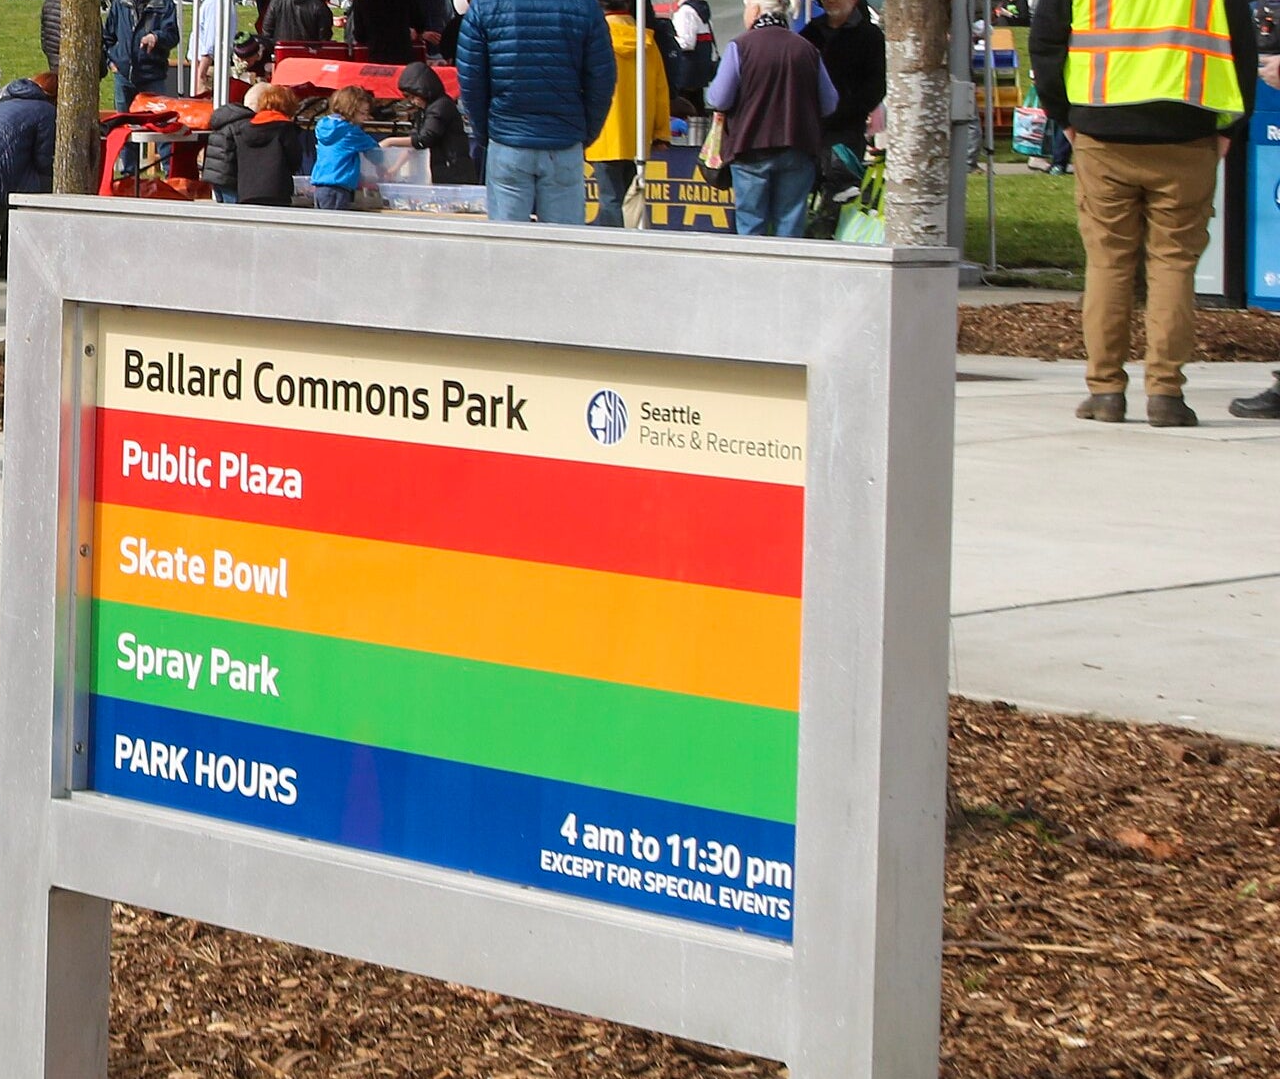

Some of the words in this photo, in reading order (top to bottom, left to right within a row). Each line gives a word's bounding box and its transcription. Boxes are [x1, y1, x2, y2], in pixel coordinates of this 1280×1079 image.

[123, 348, 242, 400] Ballard
[253, 361, 430, 421] Commons
[441, 378, 530, 431] Park
[640, 401, 701, 425] Seattle
[122, 439, 212, 488] Public
[219, 450, 303, 500] Plaza
[639, 425, 686, 450] Parks
[689, 430, 702, 450] &
[706, 431, 803, 462] Recreation
[119, 535, 206, 585] Skate
[213, 548, 288, 599] Bowl
[116, 632, 203, 690] Spray
[210, 647, 280, 697] Park
[114, 733, 189, 784] PARK
[194, 749, 298, 806] HOURS
[559, 812, 578, 846] 4
[582, 823, 625, 856] am
[629, 827, 661, 863] to
[665, 833, 741, 880] 11:30
[745, 854, 794, 890] pm
[540, 849, 605, 883] EXCEPT
[606, 863, 643, 891] FOR
[643, 870, 717, 907] SPECIAL
[718, 885, 792, 921] EVENTS
